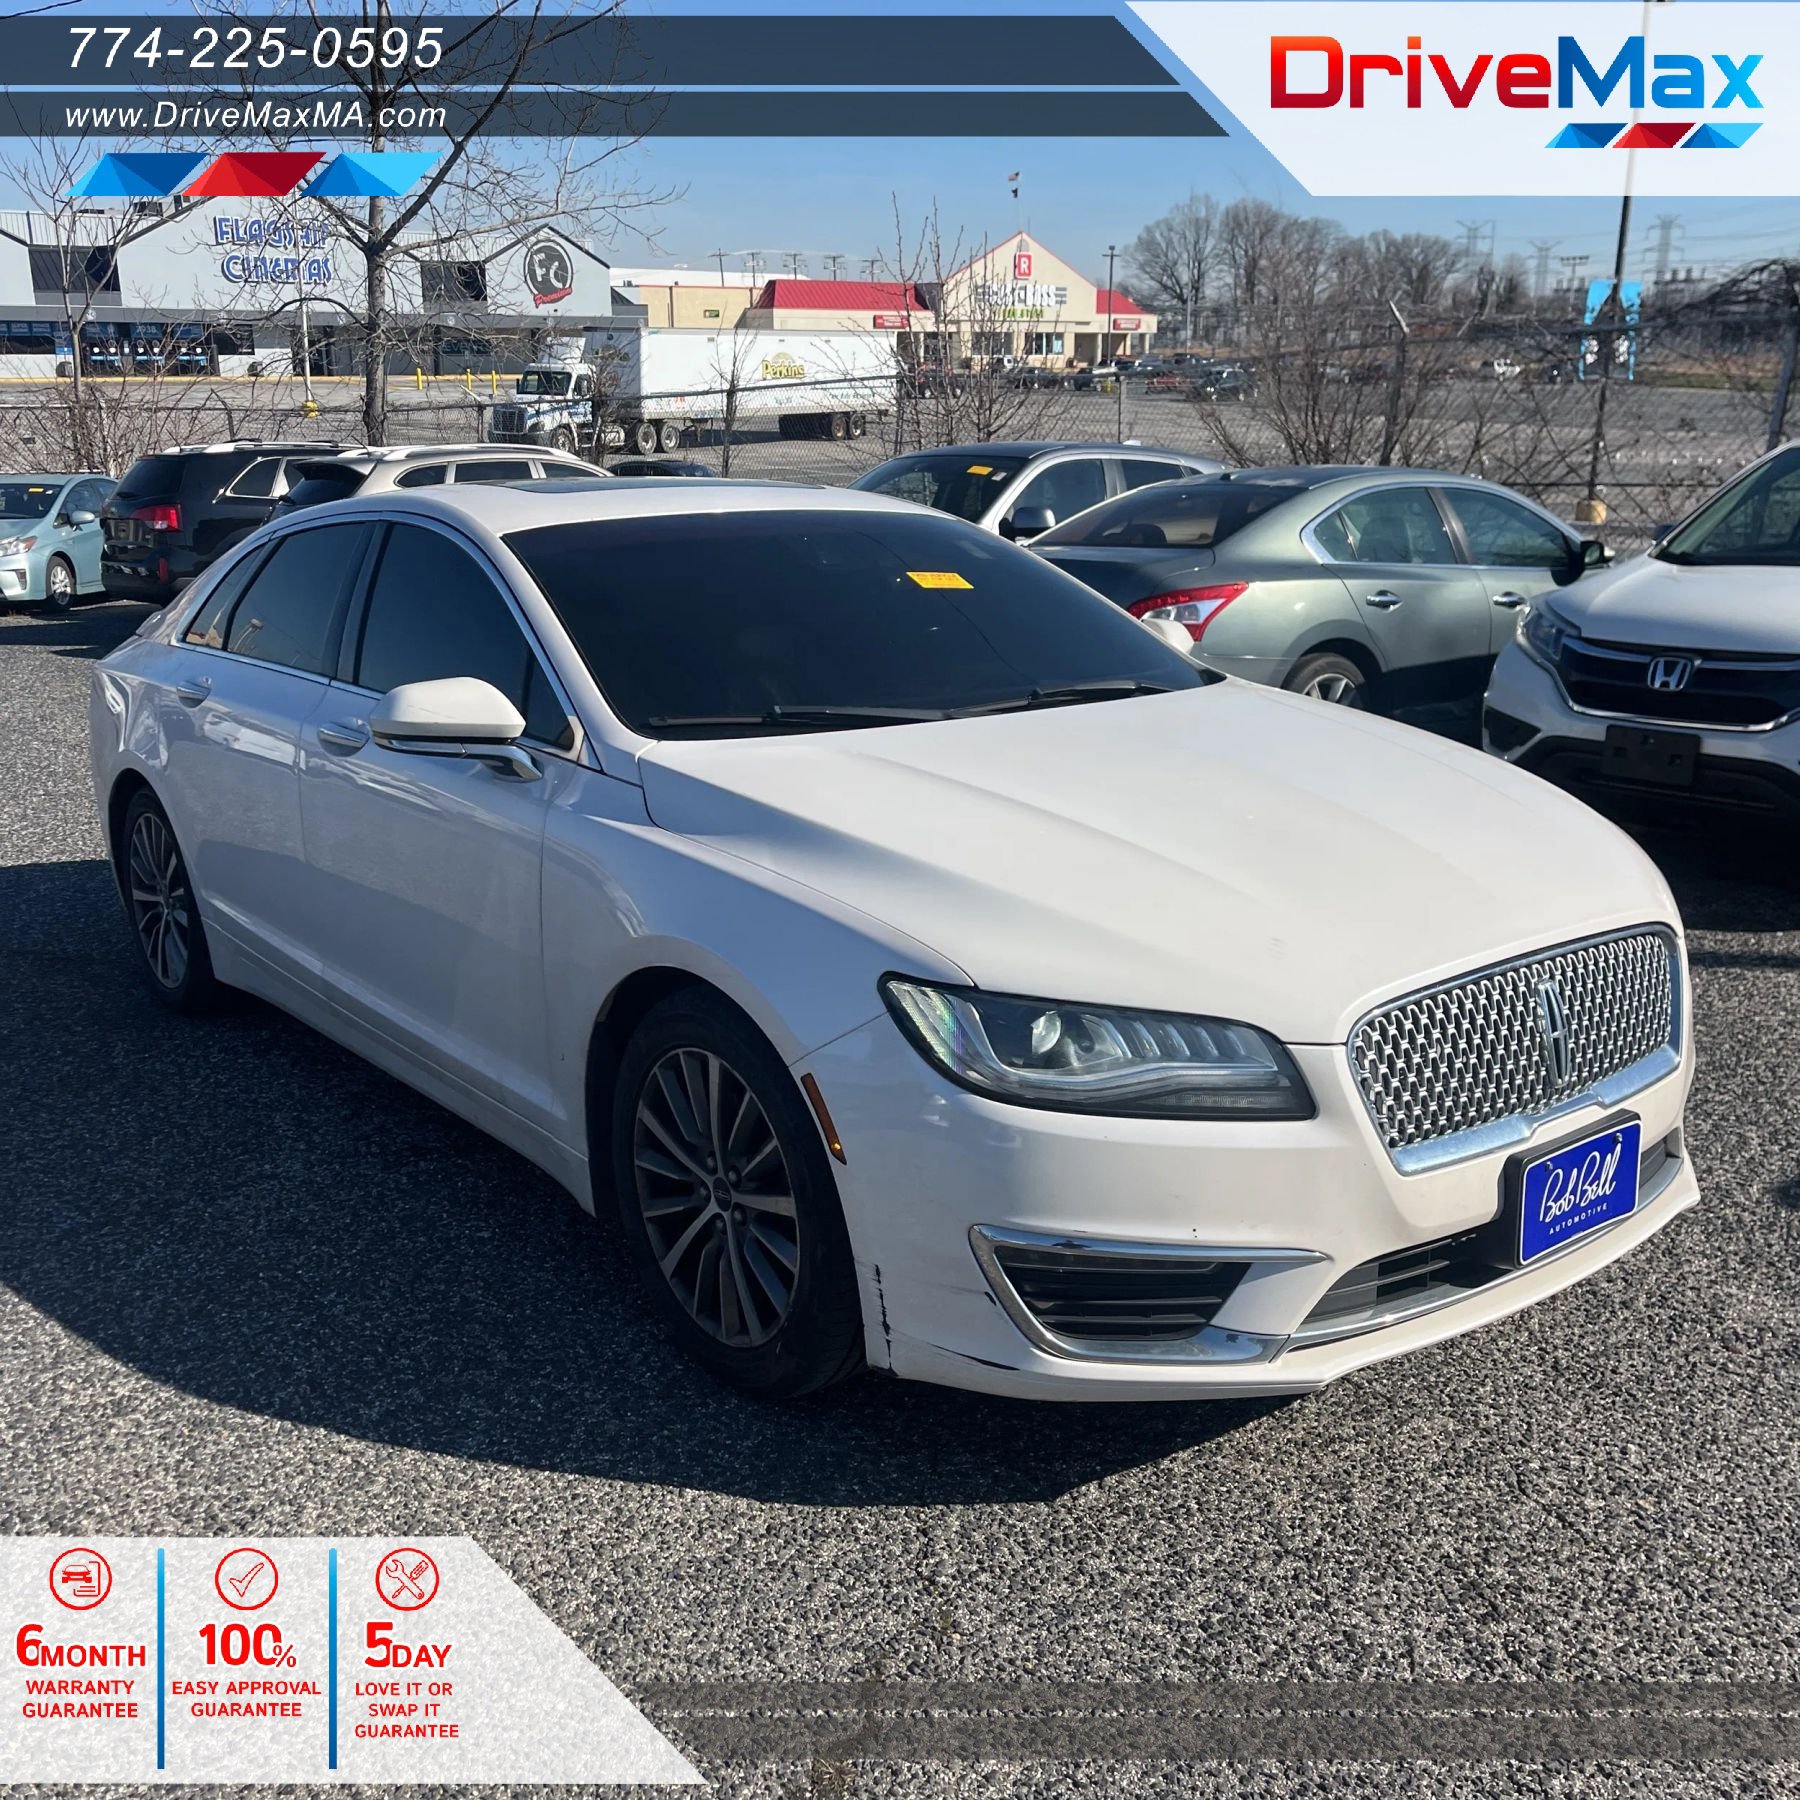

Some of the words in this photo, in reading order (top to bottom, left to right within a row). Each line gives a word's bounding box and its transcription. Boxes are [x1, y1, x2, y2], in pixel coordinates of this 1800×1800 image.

[761, 360, 805, 379] Perkins
[1540, 1168, 1577, 1222] Bob
[1576, 1143, 1621, 1207] Bell
[1549, 1202, 1608, 1235] AUTOMOTIVE
